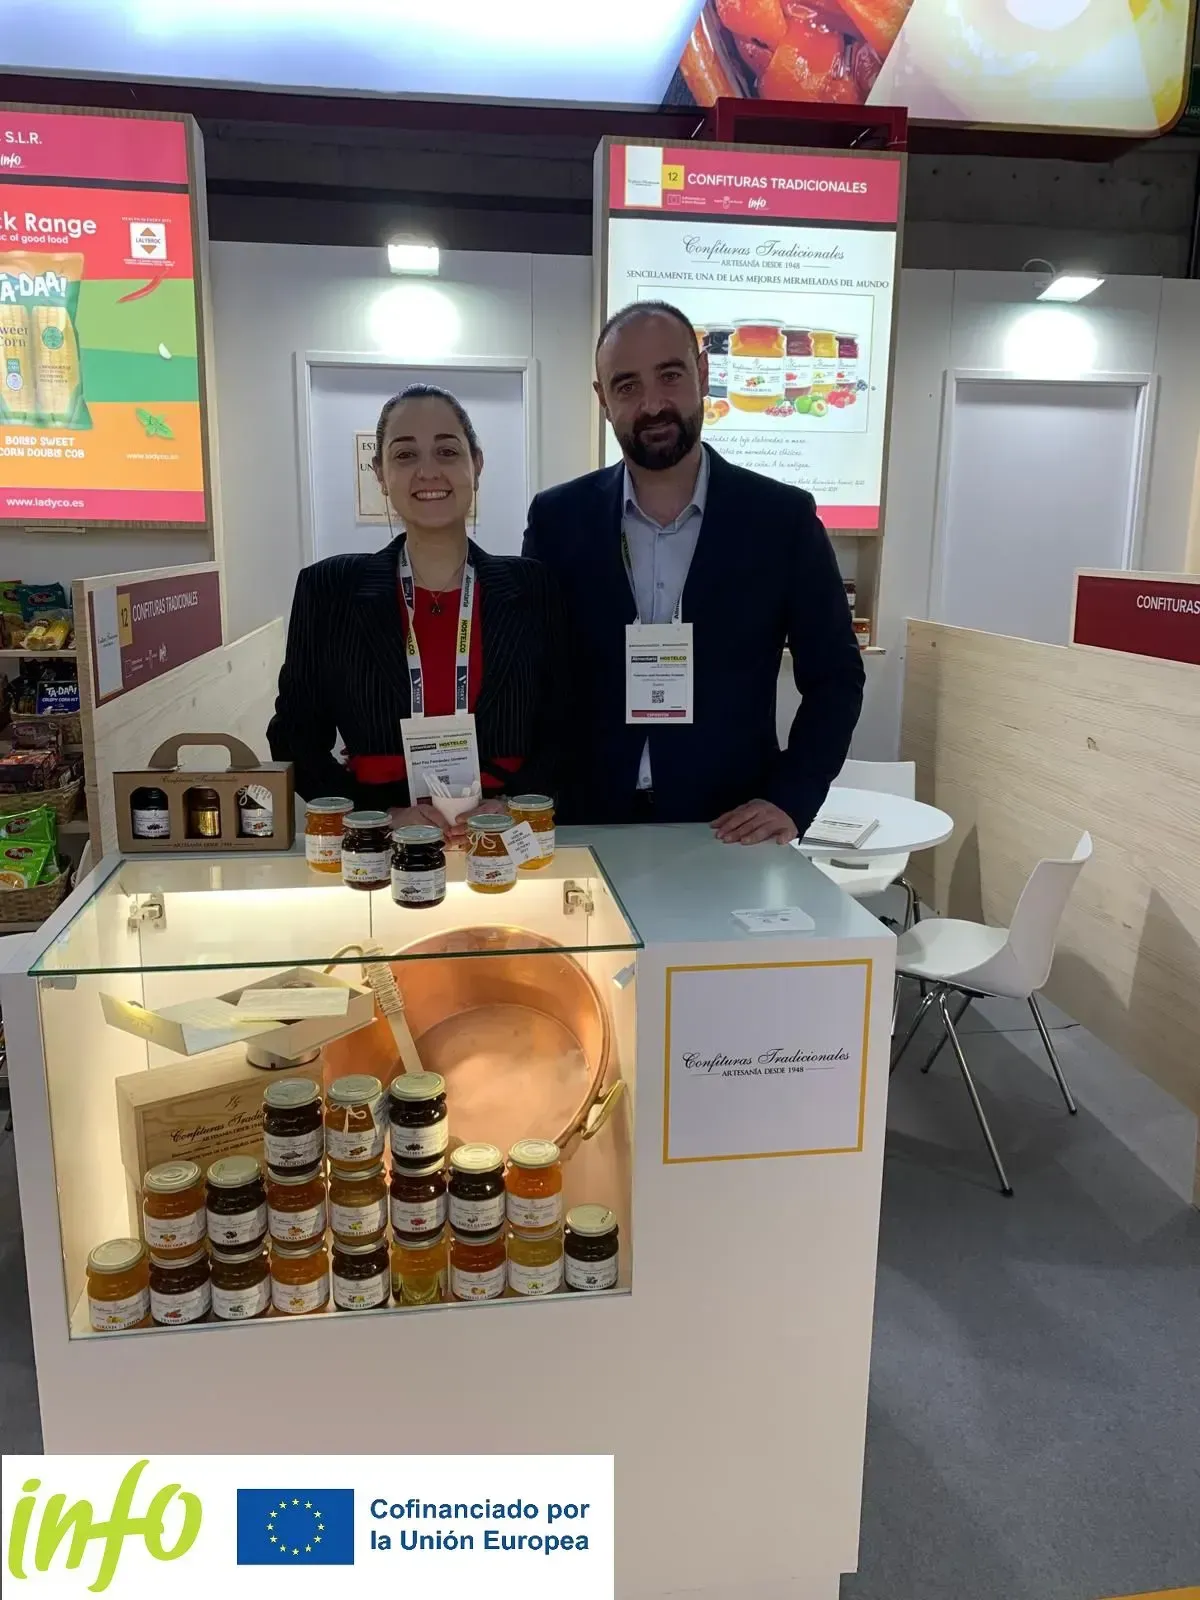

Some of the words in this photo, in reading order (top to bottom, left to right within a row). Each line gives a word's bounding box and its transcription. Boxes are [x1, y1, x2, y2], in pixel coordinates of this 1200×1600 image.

[4, 131, 42, 144] S.L.R.
[668, 172, 678, 182] 12
[688, 173, 768, 188] CONFITURAS
[771, 177, 868, 194] TRADICIONALES
[748, 196, 766, 210] info
[24, 212, 96, 238] Range
[683, 234, 750, 260] Confituras
[755, 240, 844, 260] Tradicionales
[762, 260, 782, 269] DESDE
[784, 262, 800, 270] 1948
[696, 273, 715, 282] UNA
[717, 274, 728, 282] DE
[730, 274, 744, 283] LAS
[745, 275, 782, 284] MEJORES
[783, 276, 838, 286] MERMELADAS
[840, 279, 854, 288] DEL
[856, 280, 890, 289] MUNDO
[40, 437, 76, 446] SWEET
[64, 449, 85, 458] COB
[6, 498, 85, 508] www.ladyco.es
[121, 608, 129, 628] 12
[132, 598, 166, 622] CONFITURAS
[166, 590, 198, 613] TRADICIONALES
[1136, 594, 1200, 614] CONFITURAS
[460, 620, 468, 653] HOSTELCO
[438, 740, 468, 748] HOSTELCO
[682, 1052, 752, 1073] Confituras
[758, 1047, 851, 1065] Tradicionales
[721, 1068, 762, 1078] ARTESANÍA
[764, 1067, 786, 1076] DESDE
[170, 1124, 225, 1142] Confituras
